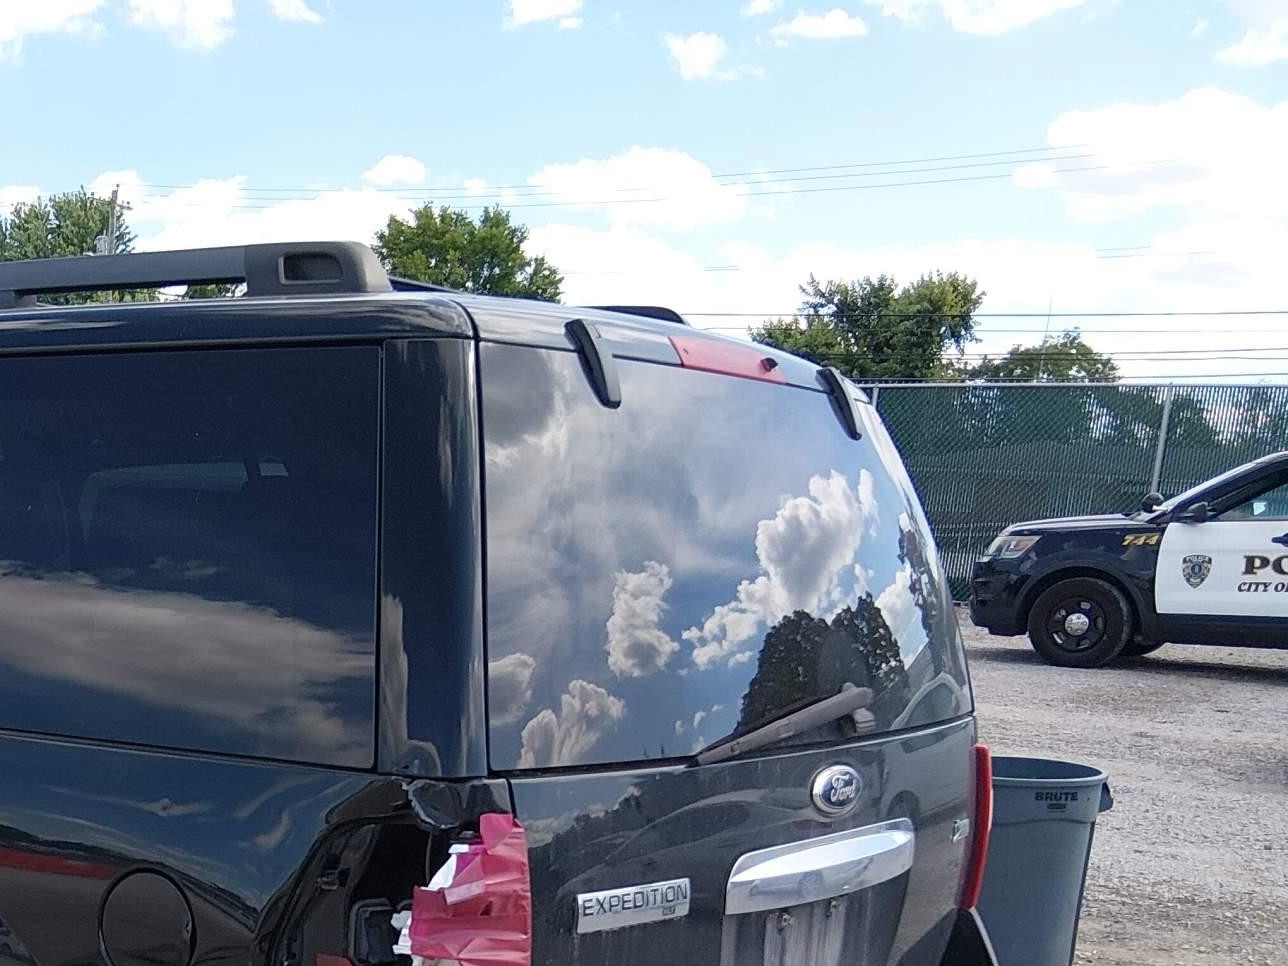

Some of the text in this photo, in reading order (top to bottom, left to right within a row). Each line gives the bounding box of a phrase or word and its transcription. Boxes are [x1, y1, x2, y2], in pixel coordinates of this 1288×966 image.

[1122, 534, 1160, 546] 744
[1237, 582, 1272, 592] CITY
[830, 774, 857, 802] Ford
[1034, 791, 1079, 801] BRUTE
[583, 883, 688, 916] EXPEDITION
